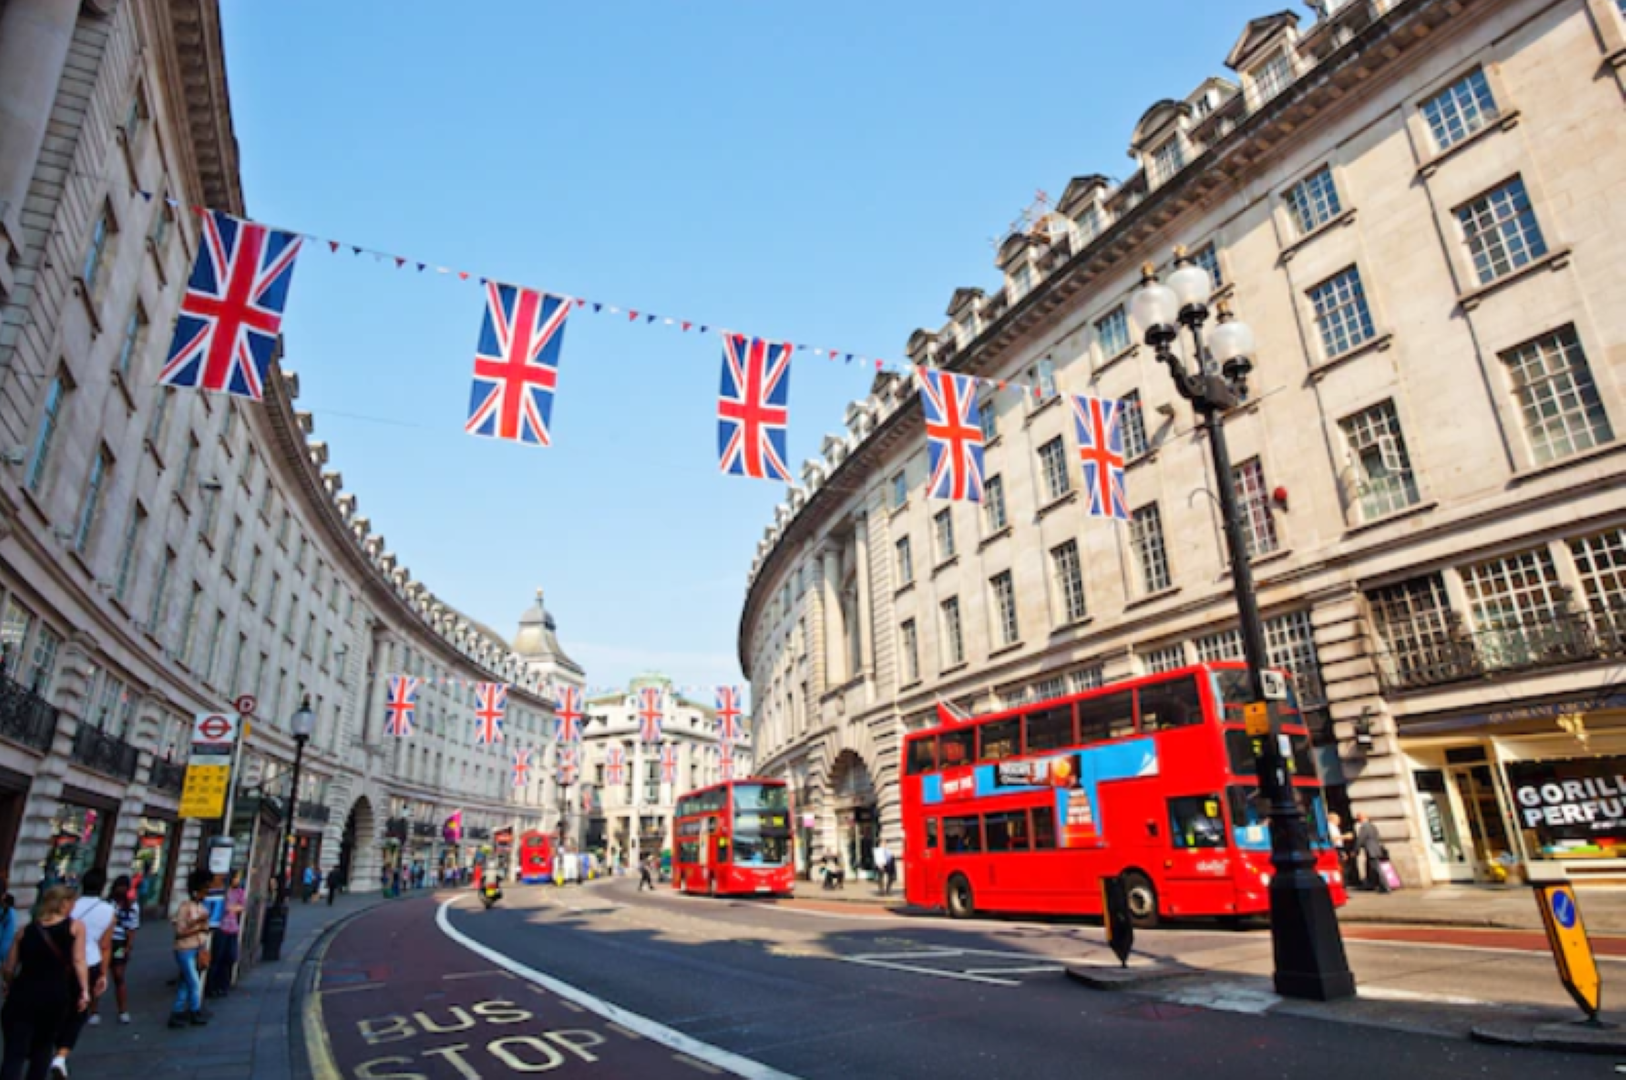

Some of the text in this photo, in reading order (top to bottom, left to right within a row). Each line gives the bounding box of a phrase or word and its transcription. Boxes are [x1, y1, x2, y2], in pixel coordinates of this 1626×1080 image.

[1523, 797, 1626, 828] PERFU
[357, 1000, 533, 1045] BUS
[353, 1029, 606, 1080] STOP
